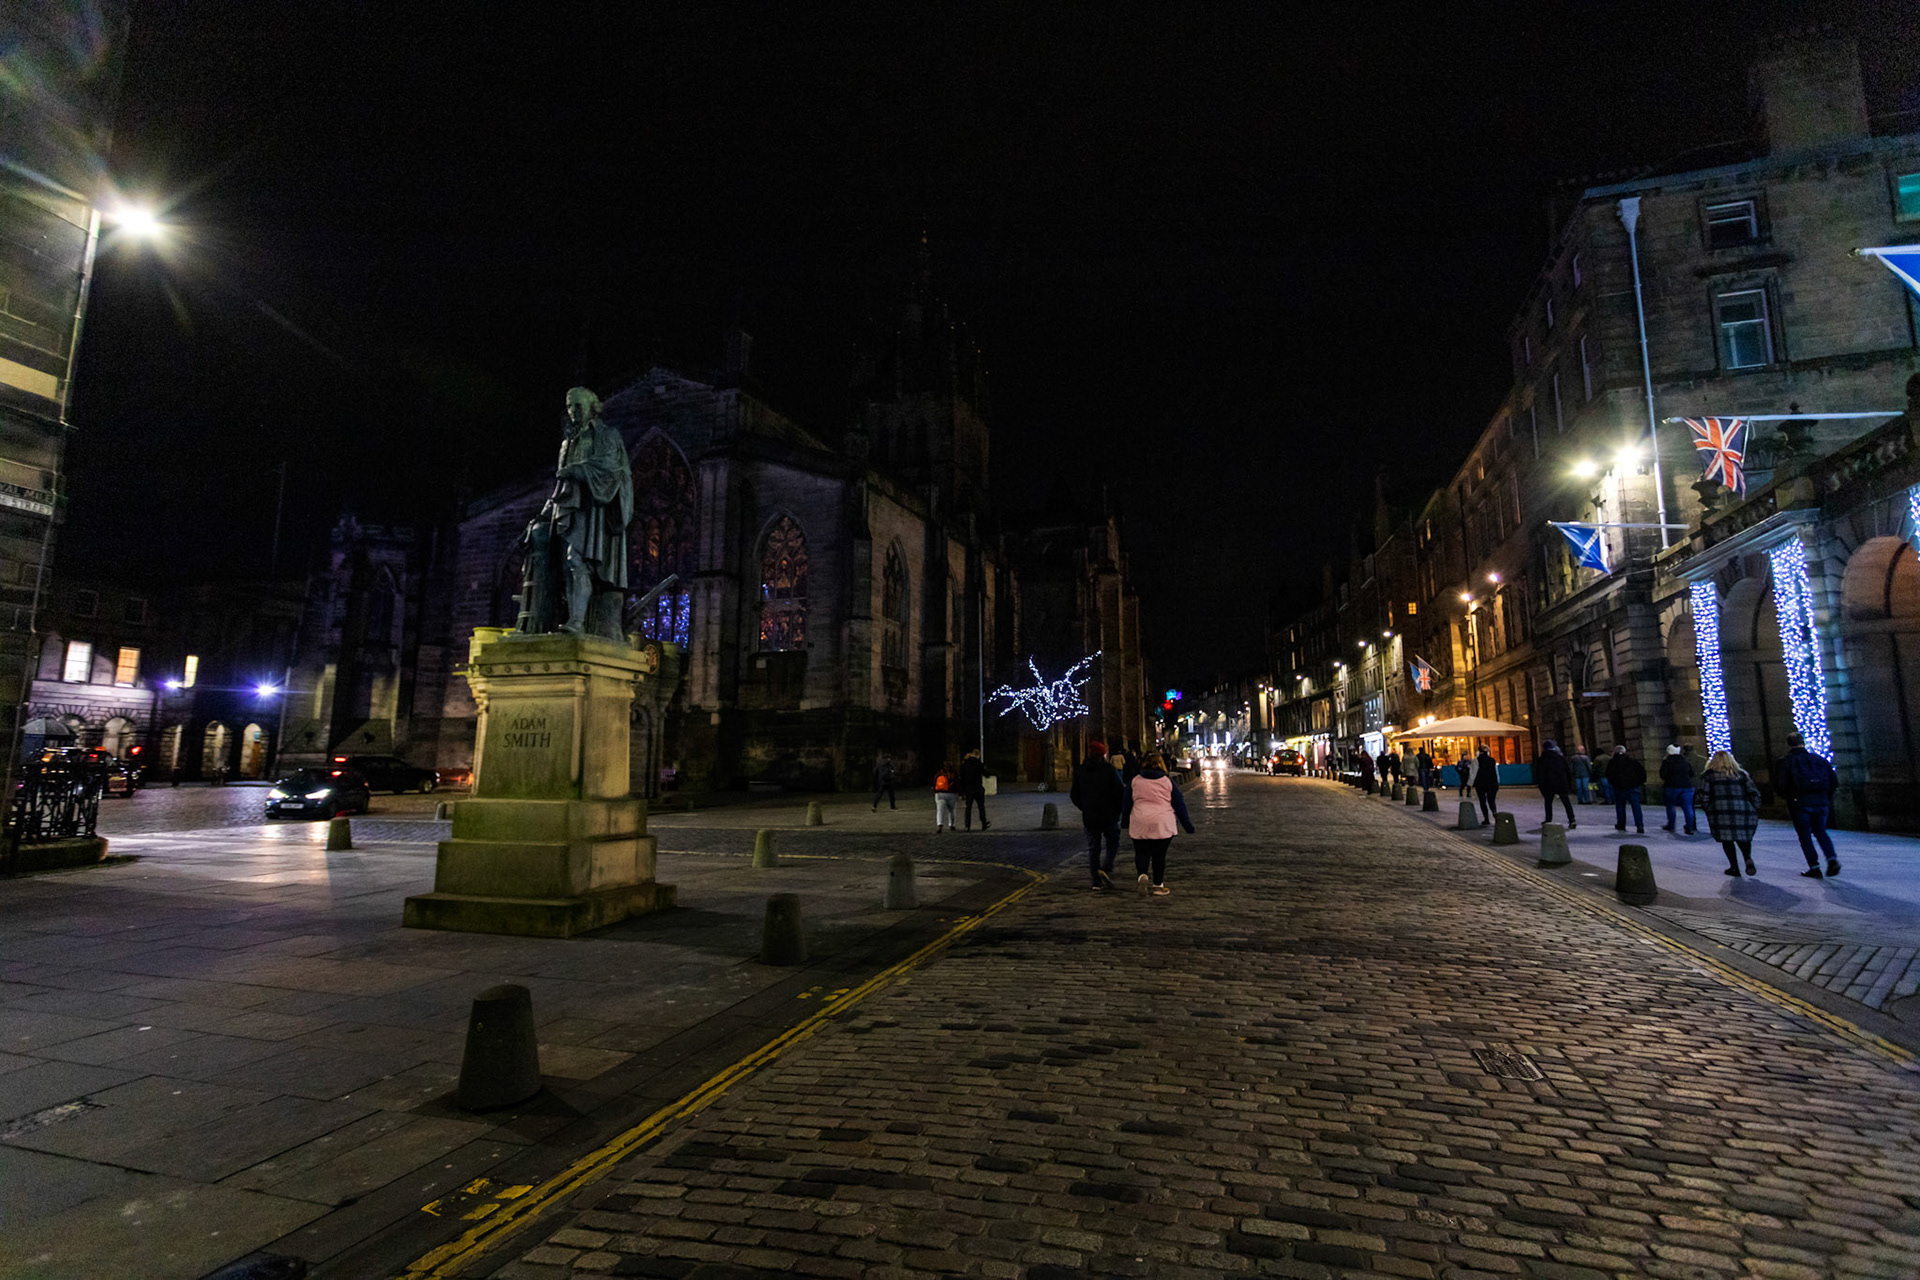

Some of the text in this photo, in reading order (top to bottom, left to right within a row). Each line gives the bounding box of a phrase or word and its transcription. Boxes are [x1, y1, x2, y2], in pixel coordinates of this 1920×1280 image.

[12, 498, 50, 515] STREET
[511, 717, 546, 730] ADAM
[503, 732, 551, 748] SMITH
